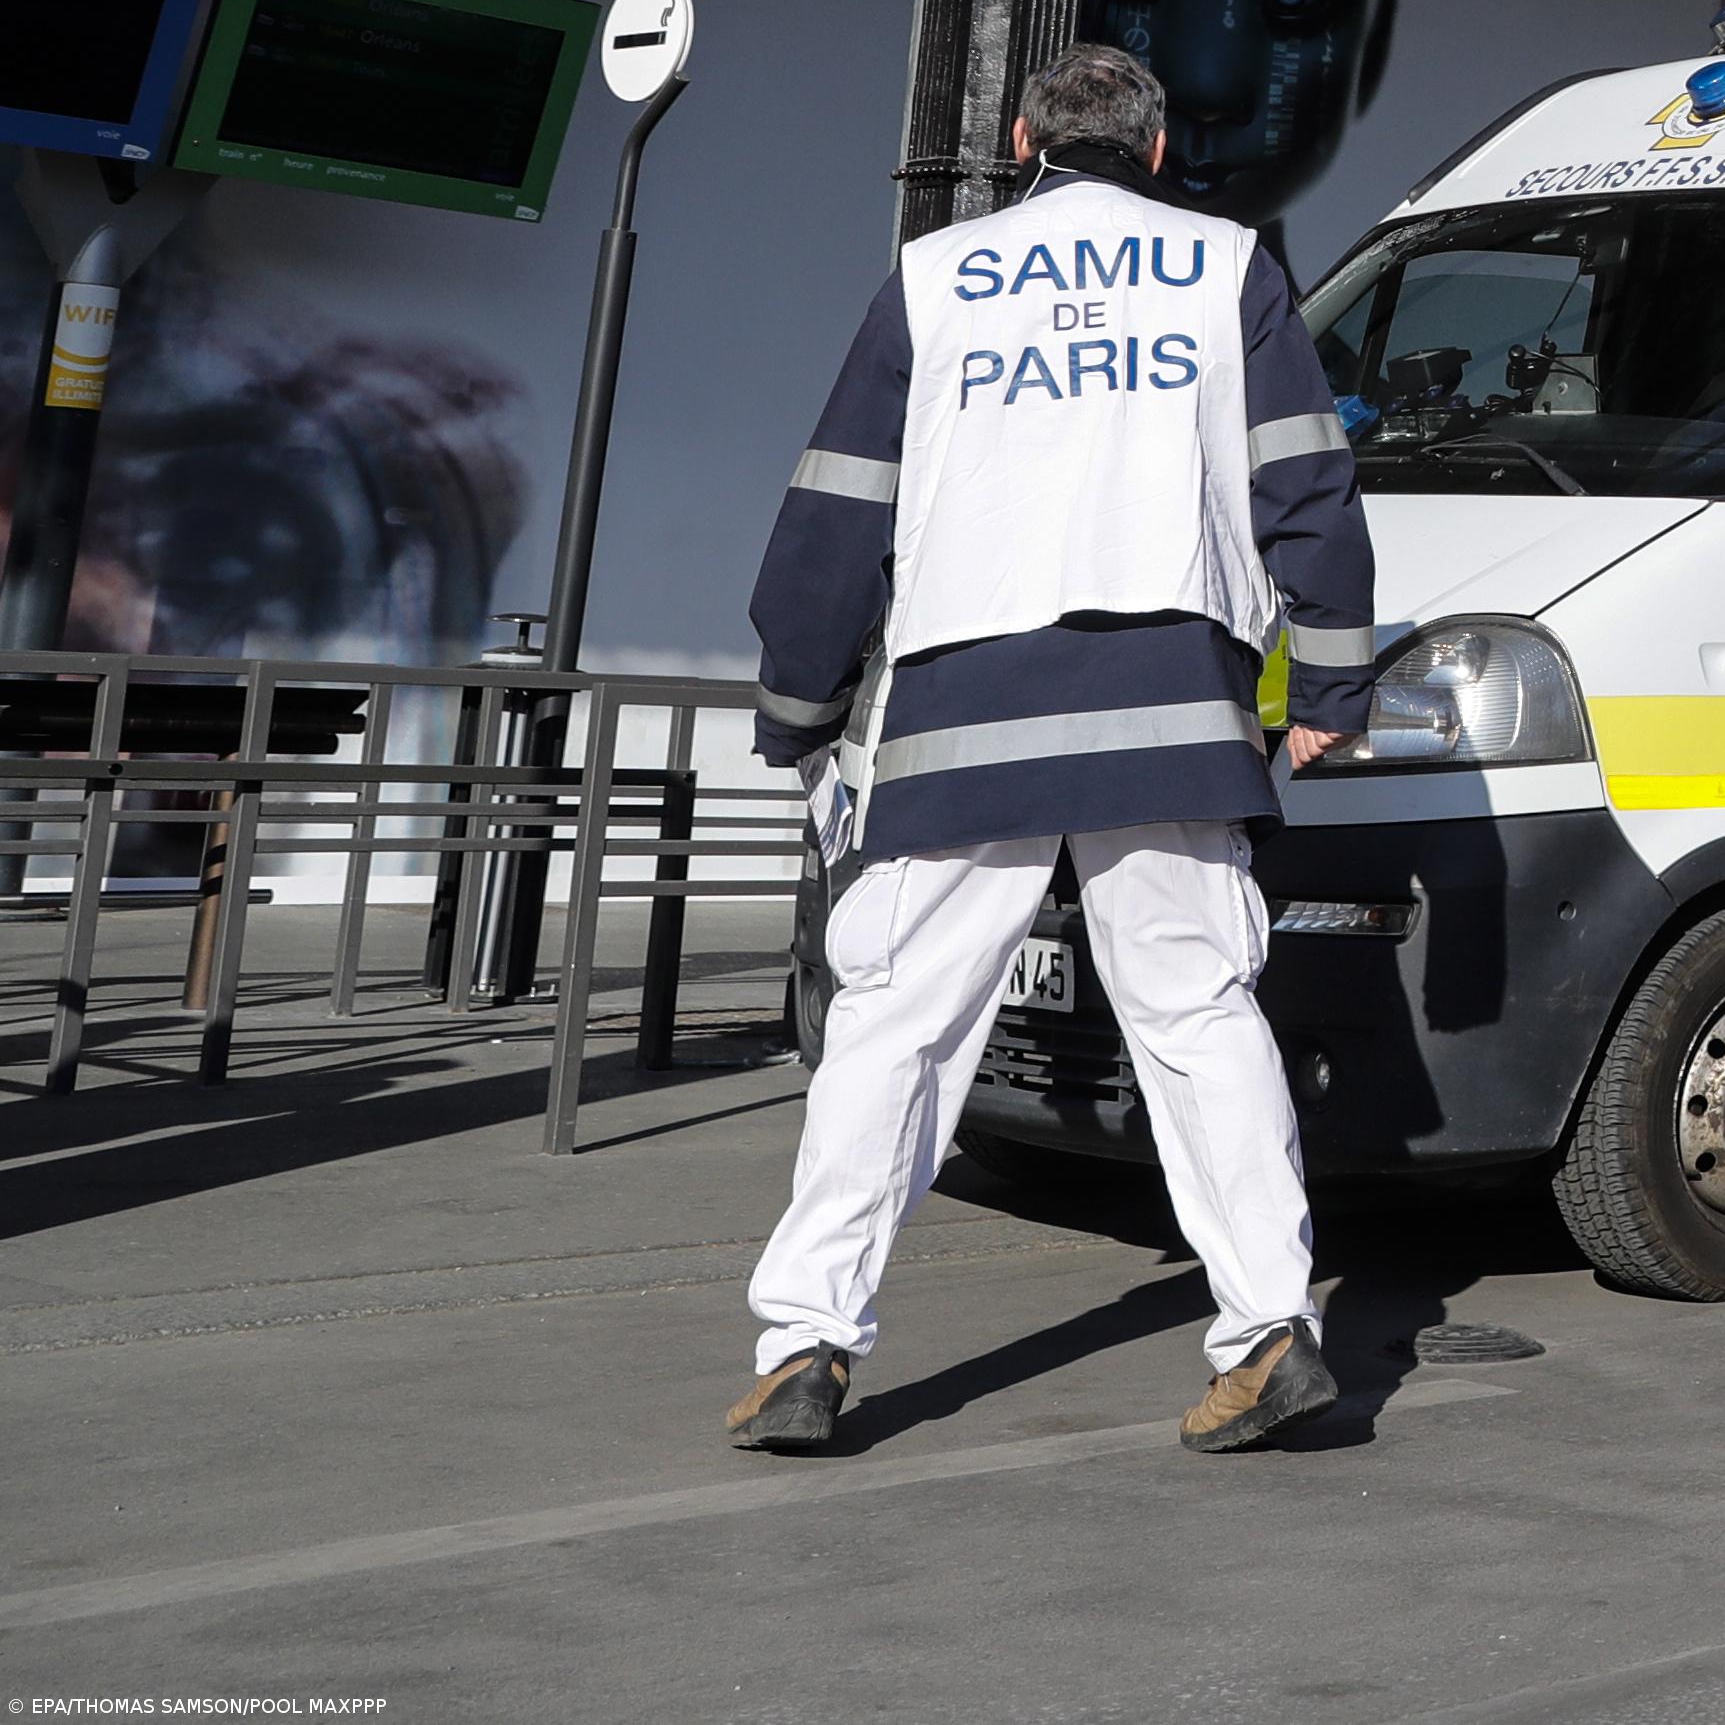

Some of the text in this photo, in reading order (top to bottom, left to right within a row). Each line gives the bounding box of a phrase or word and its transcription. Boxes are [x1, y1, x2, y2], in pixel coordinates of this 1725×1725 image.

[96, 129, 121, 140] voie
[1505, 158, 1646, 198] SECOURS
[954, 236, 1205, 301] SAMU
[64, 304, 116, 325] WIF
[1053, 301, 1106, 332] DE
[959, 333, 1199, 411] PARIS
[53, 388, 104, 403] ILLIMIT
[1033, 951, 1065, 1001] 45
